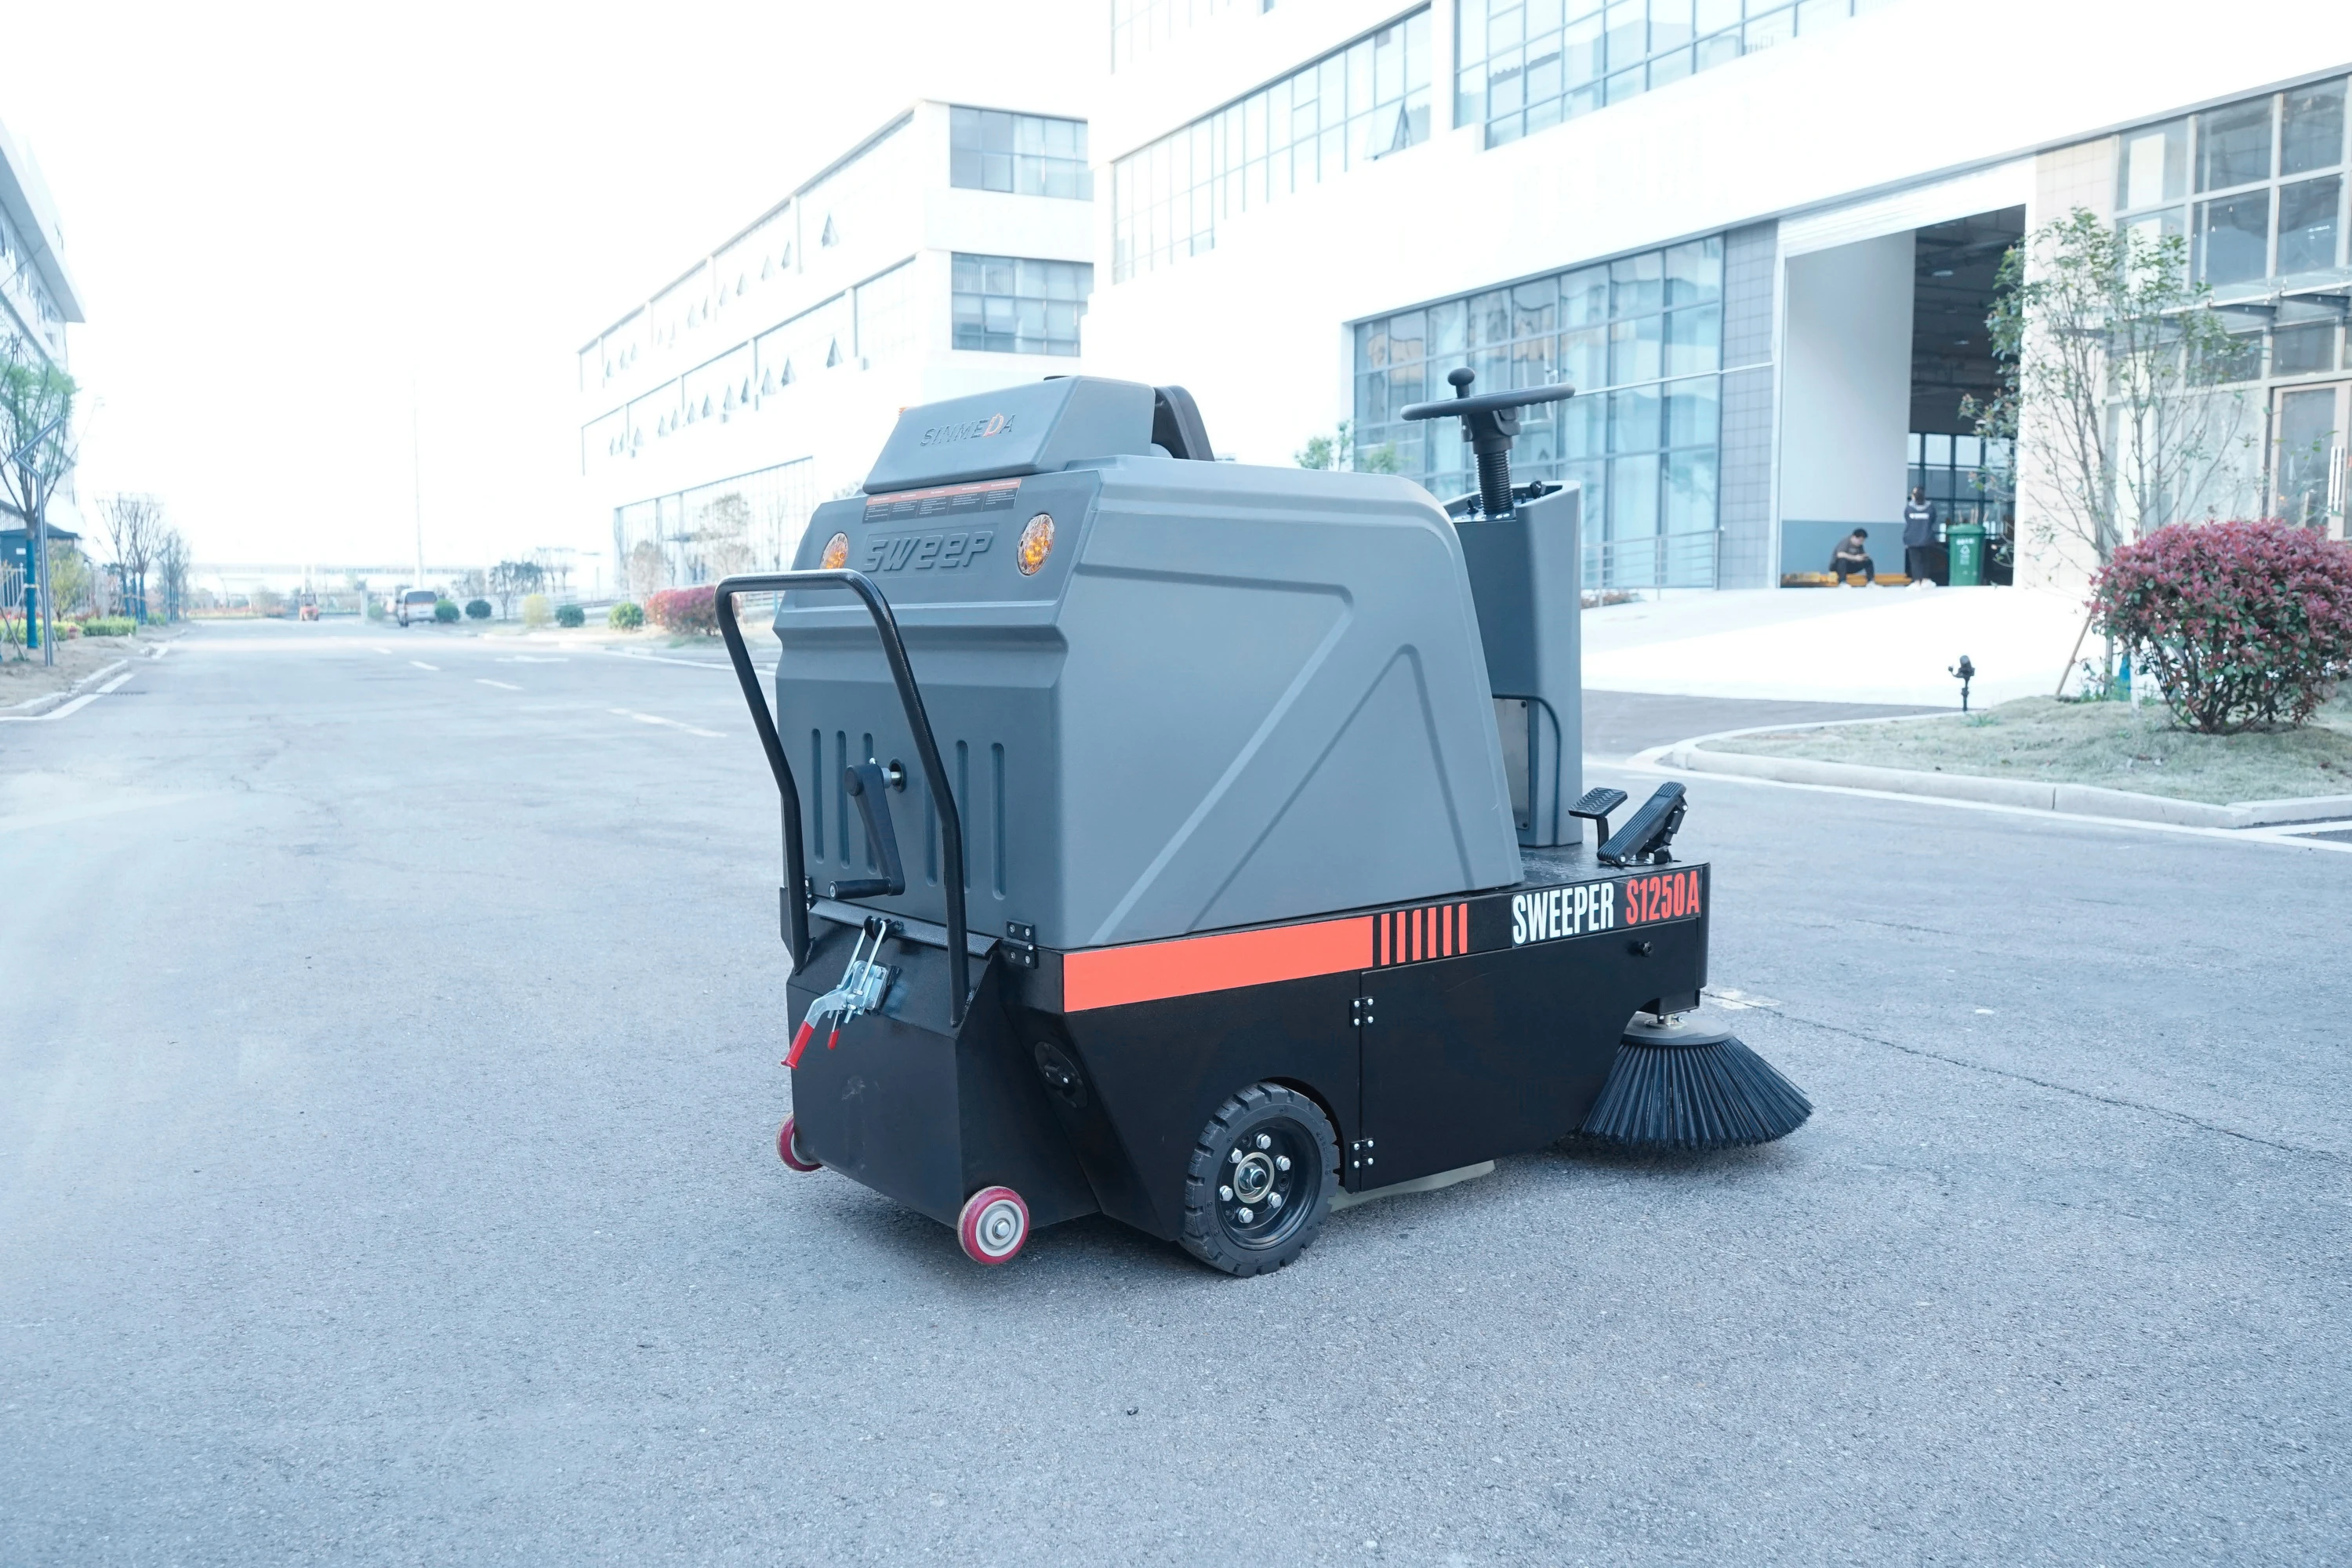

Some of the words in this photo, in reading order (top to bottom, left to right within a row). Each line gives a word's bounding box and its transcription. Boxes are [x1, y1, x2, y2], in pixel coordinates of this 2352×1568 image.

[920, 413, 1016, 446] SINMEDA
[1512, 882, 1614, 945] SWEEPER
[1625, 870, 1700, 925] S1250A
